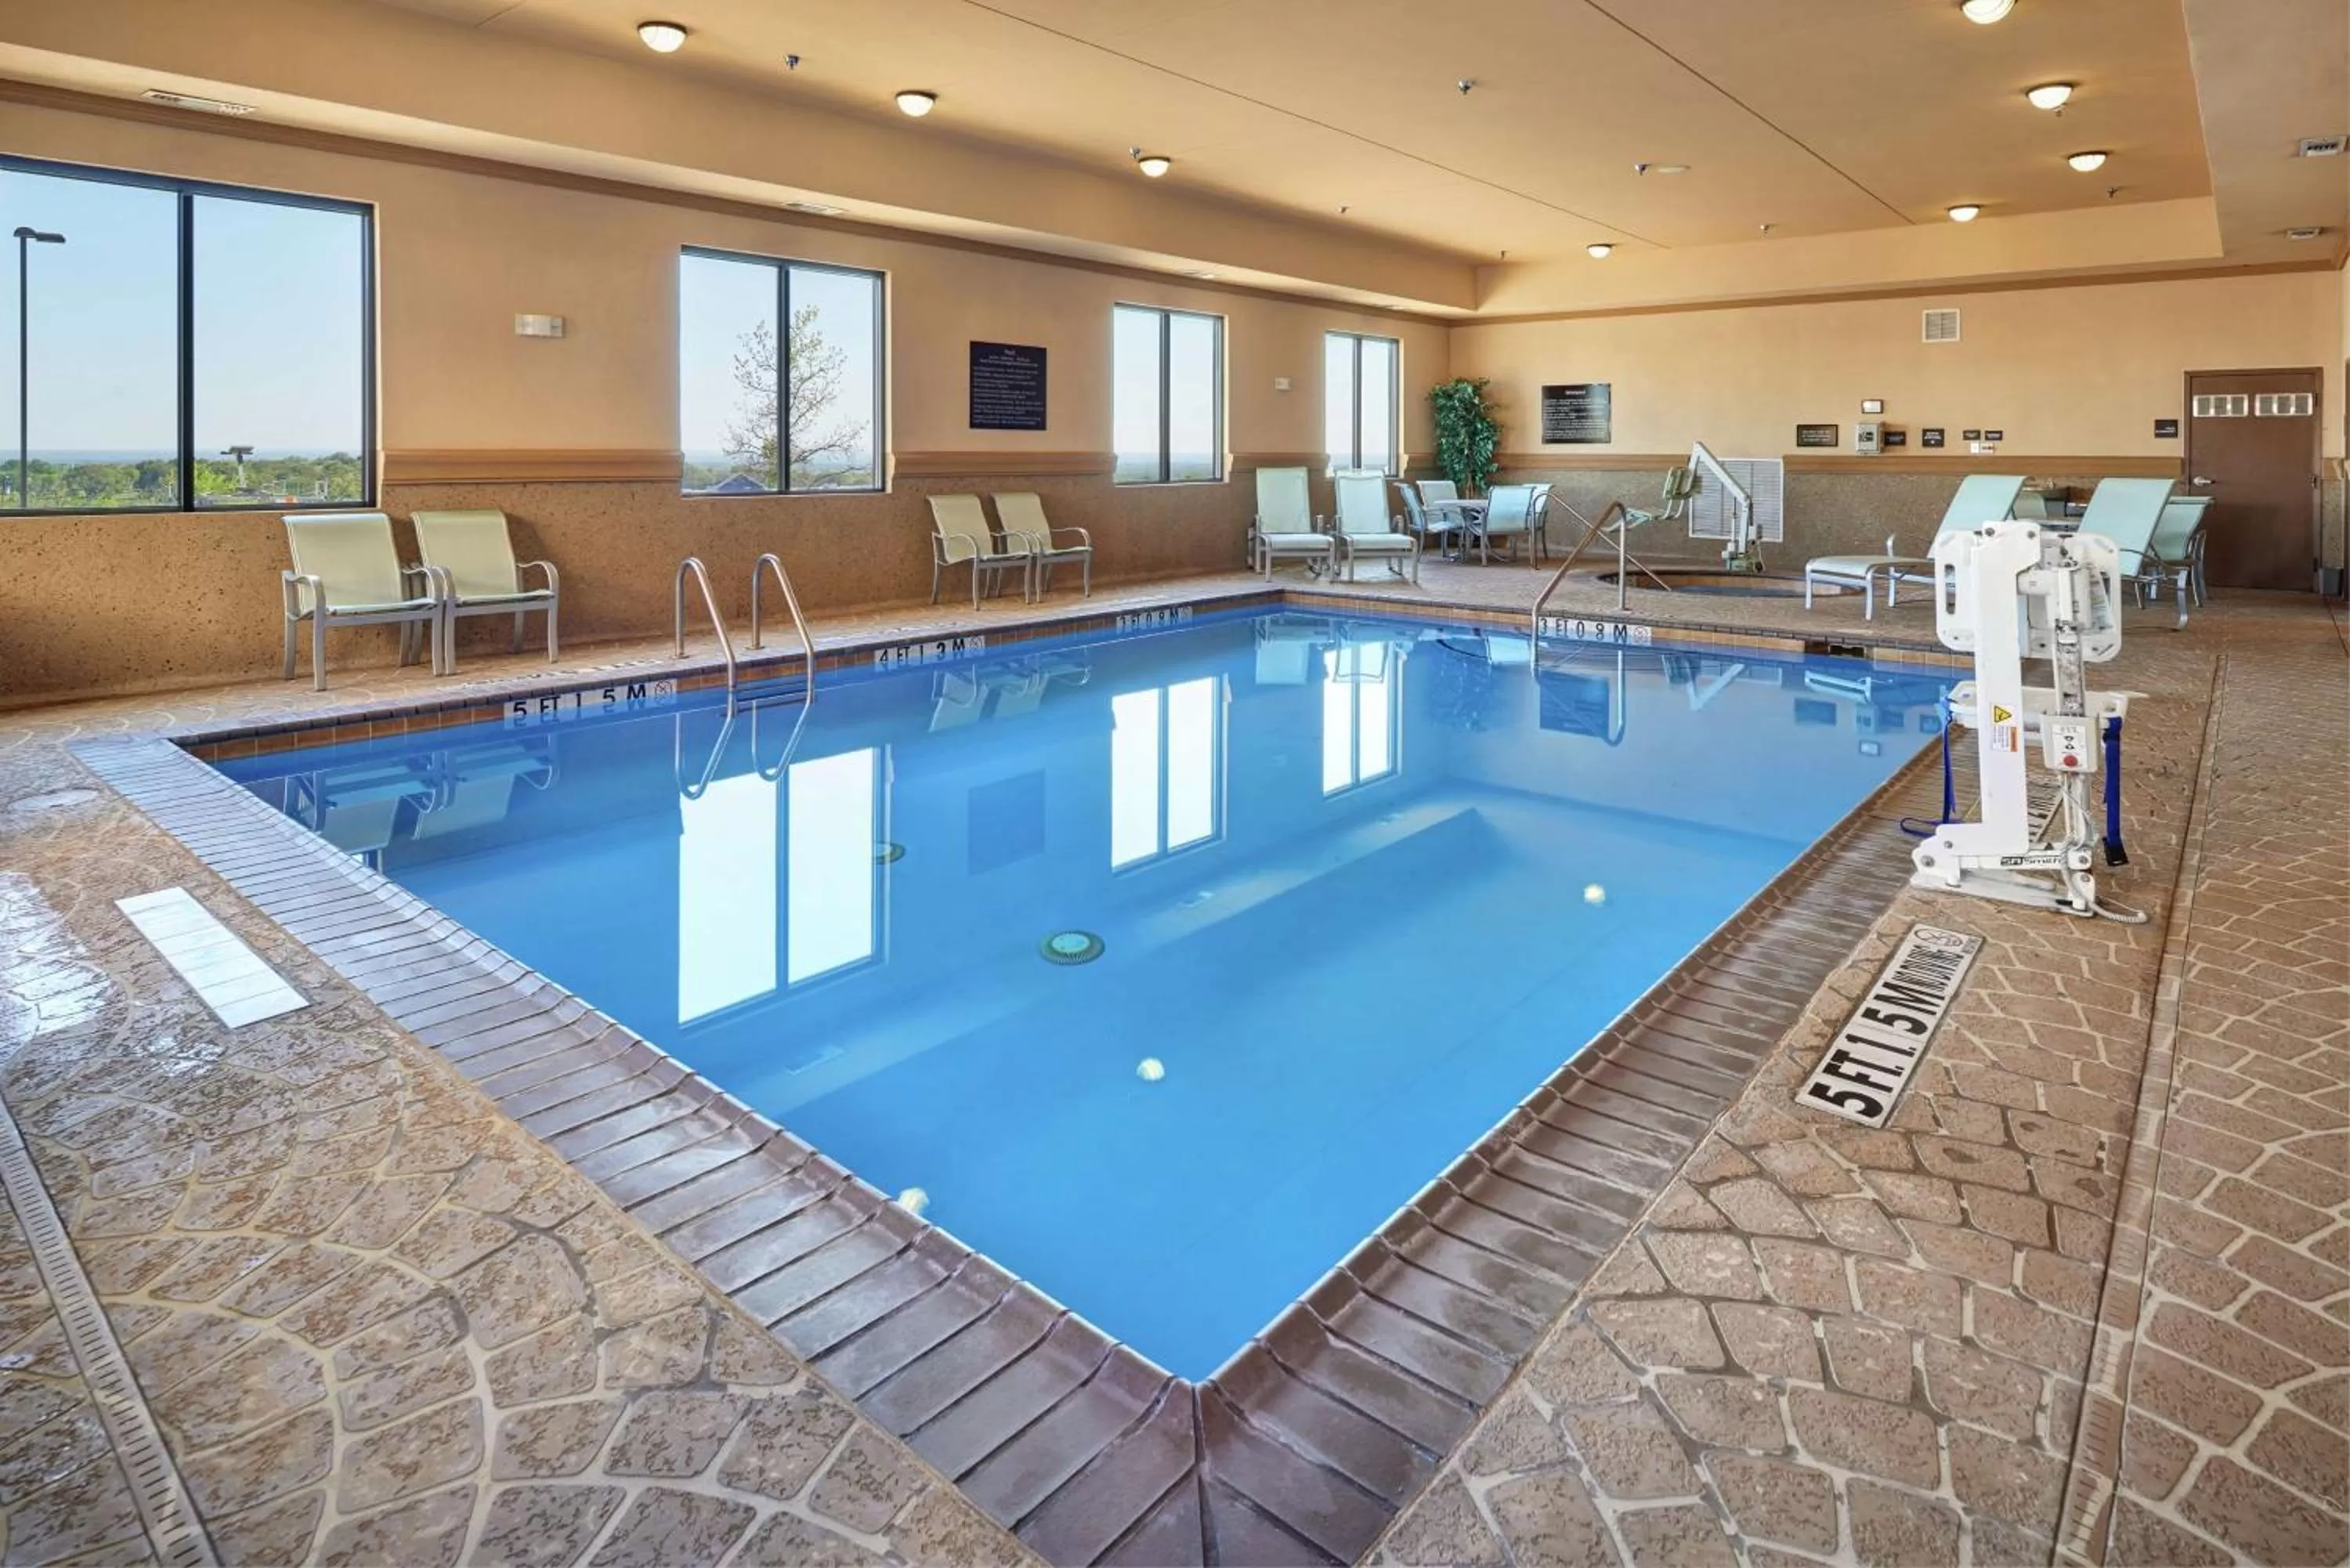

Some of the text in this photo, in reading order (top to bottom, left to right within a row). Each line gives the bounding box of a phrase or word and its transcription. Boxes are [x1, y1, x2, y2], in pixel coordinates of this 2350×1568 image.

[1614, 624, 1627, 641] M
[512, 701, 528, 717] 5
[540, 696, 562, 715] FT
[602, 688, 616, 703] 5
[627, 684, 646, 701] M
[1808, 1082, 1884, 1118] 5
